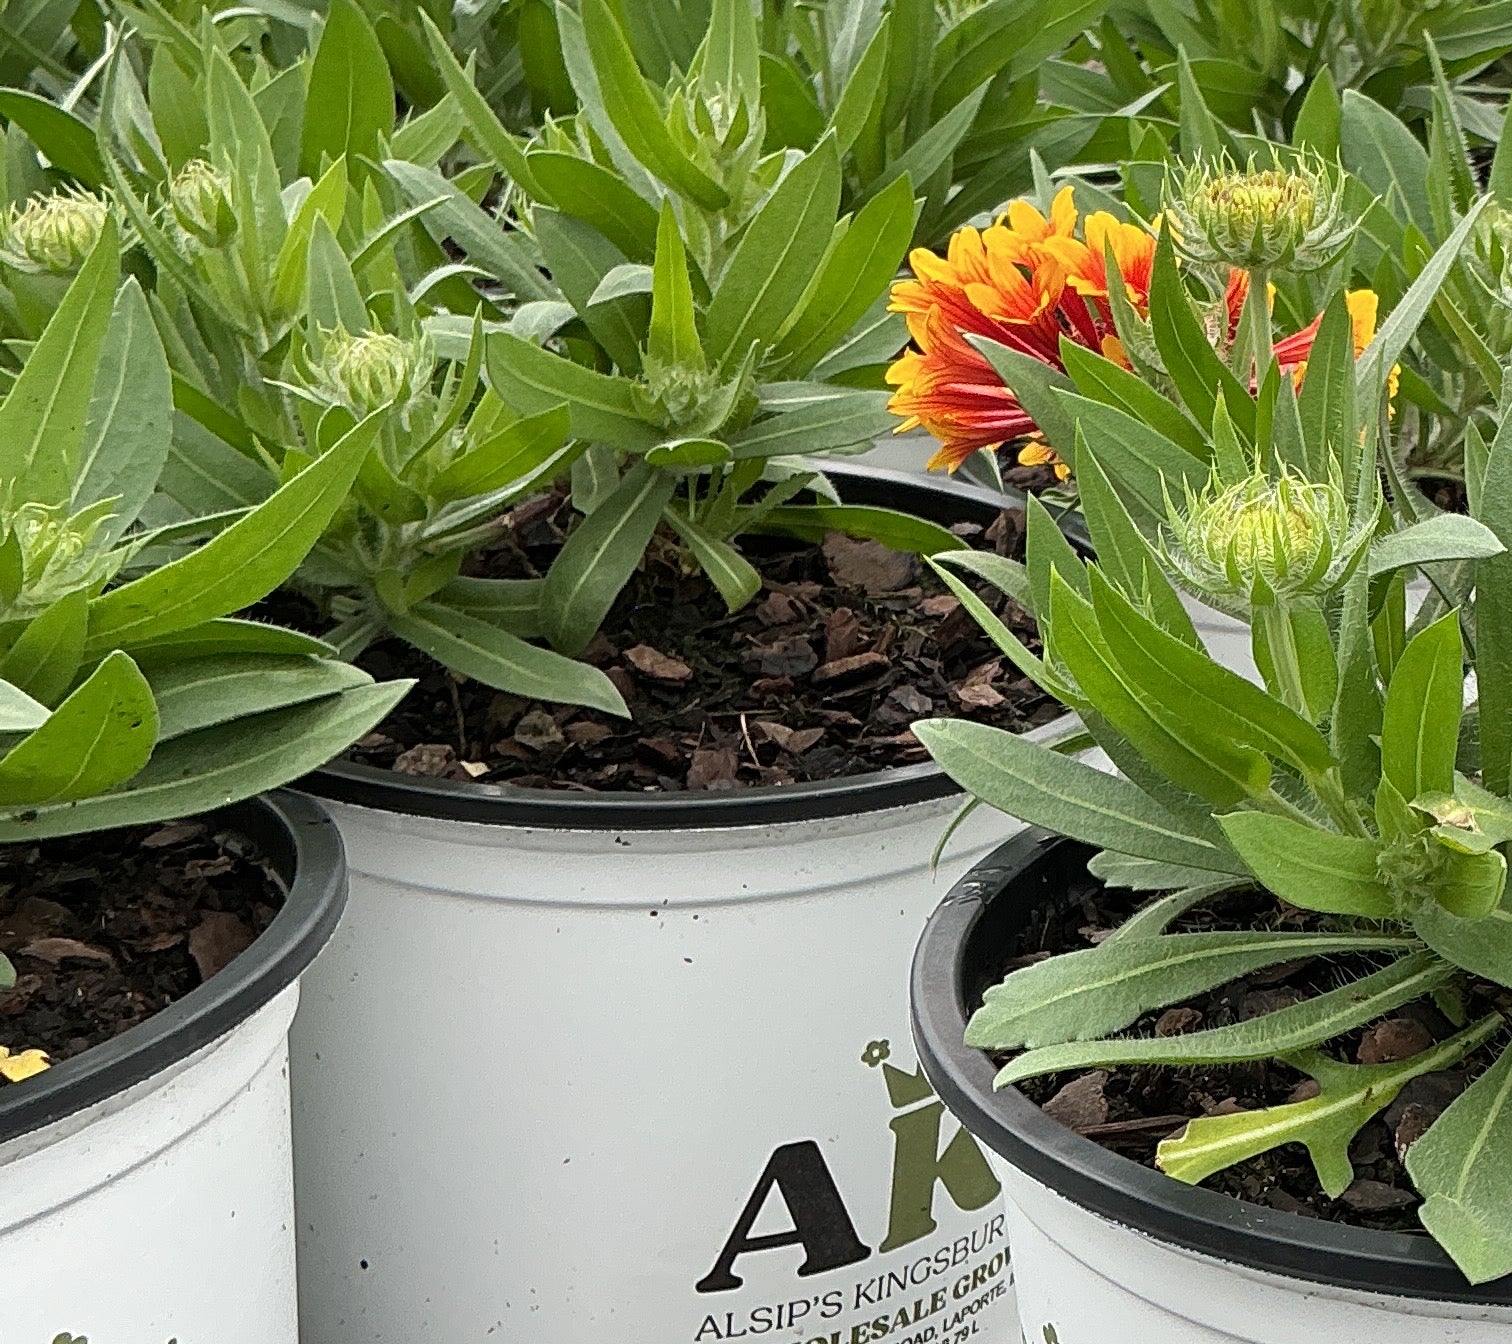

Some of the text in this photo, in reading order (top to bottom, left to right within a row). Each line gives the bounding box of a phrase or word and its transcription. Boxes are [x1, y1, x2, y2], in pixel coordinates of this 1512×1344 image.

[694, 1101, 1003, 1294] AK
[694, 1212, 1005, 1343] ALSIP'S KINGSBUR
[971, 1319, 980, 1335] L
